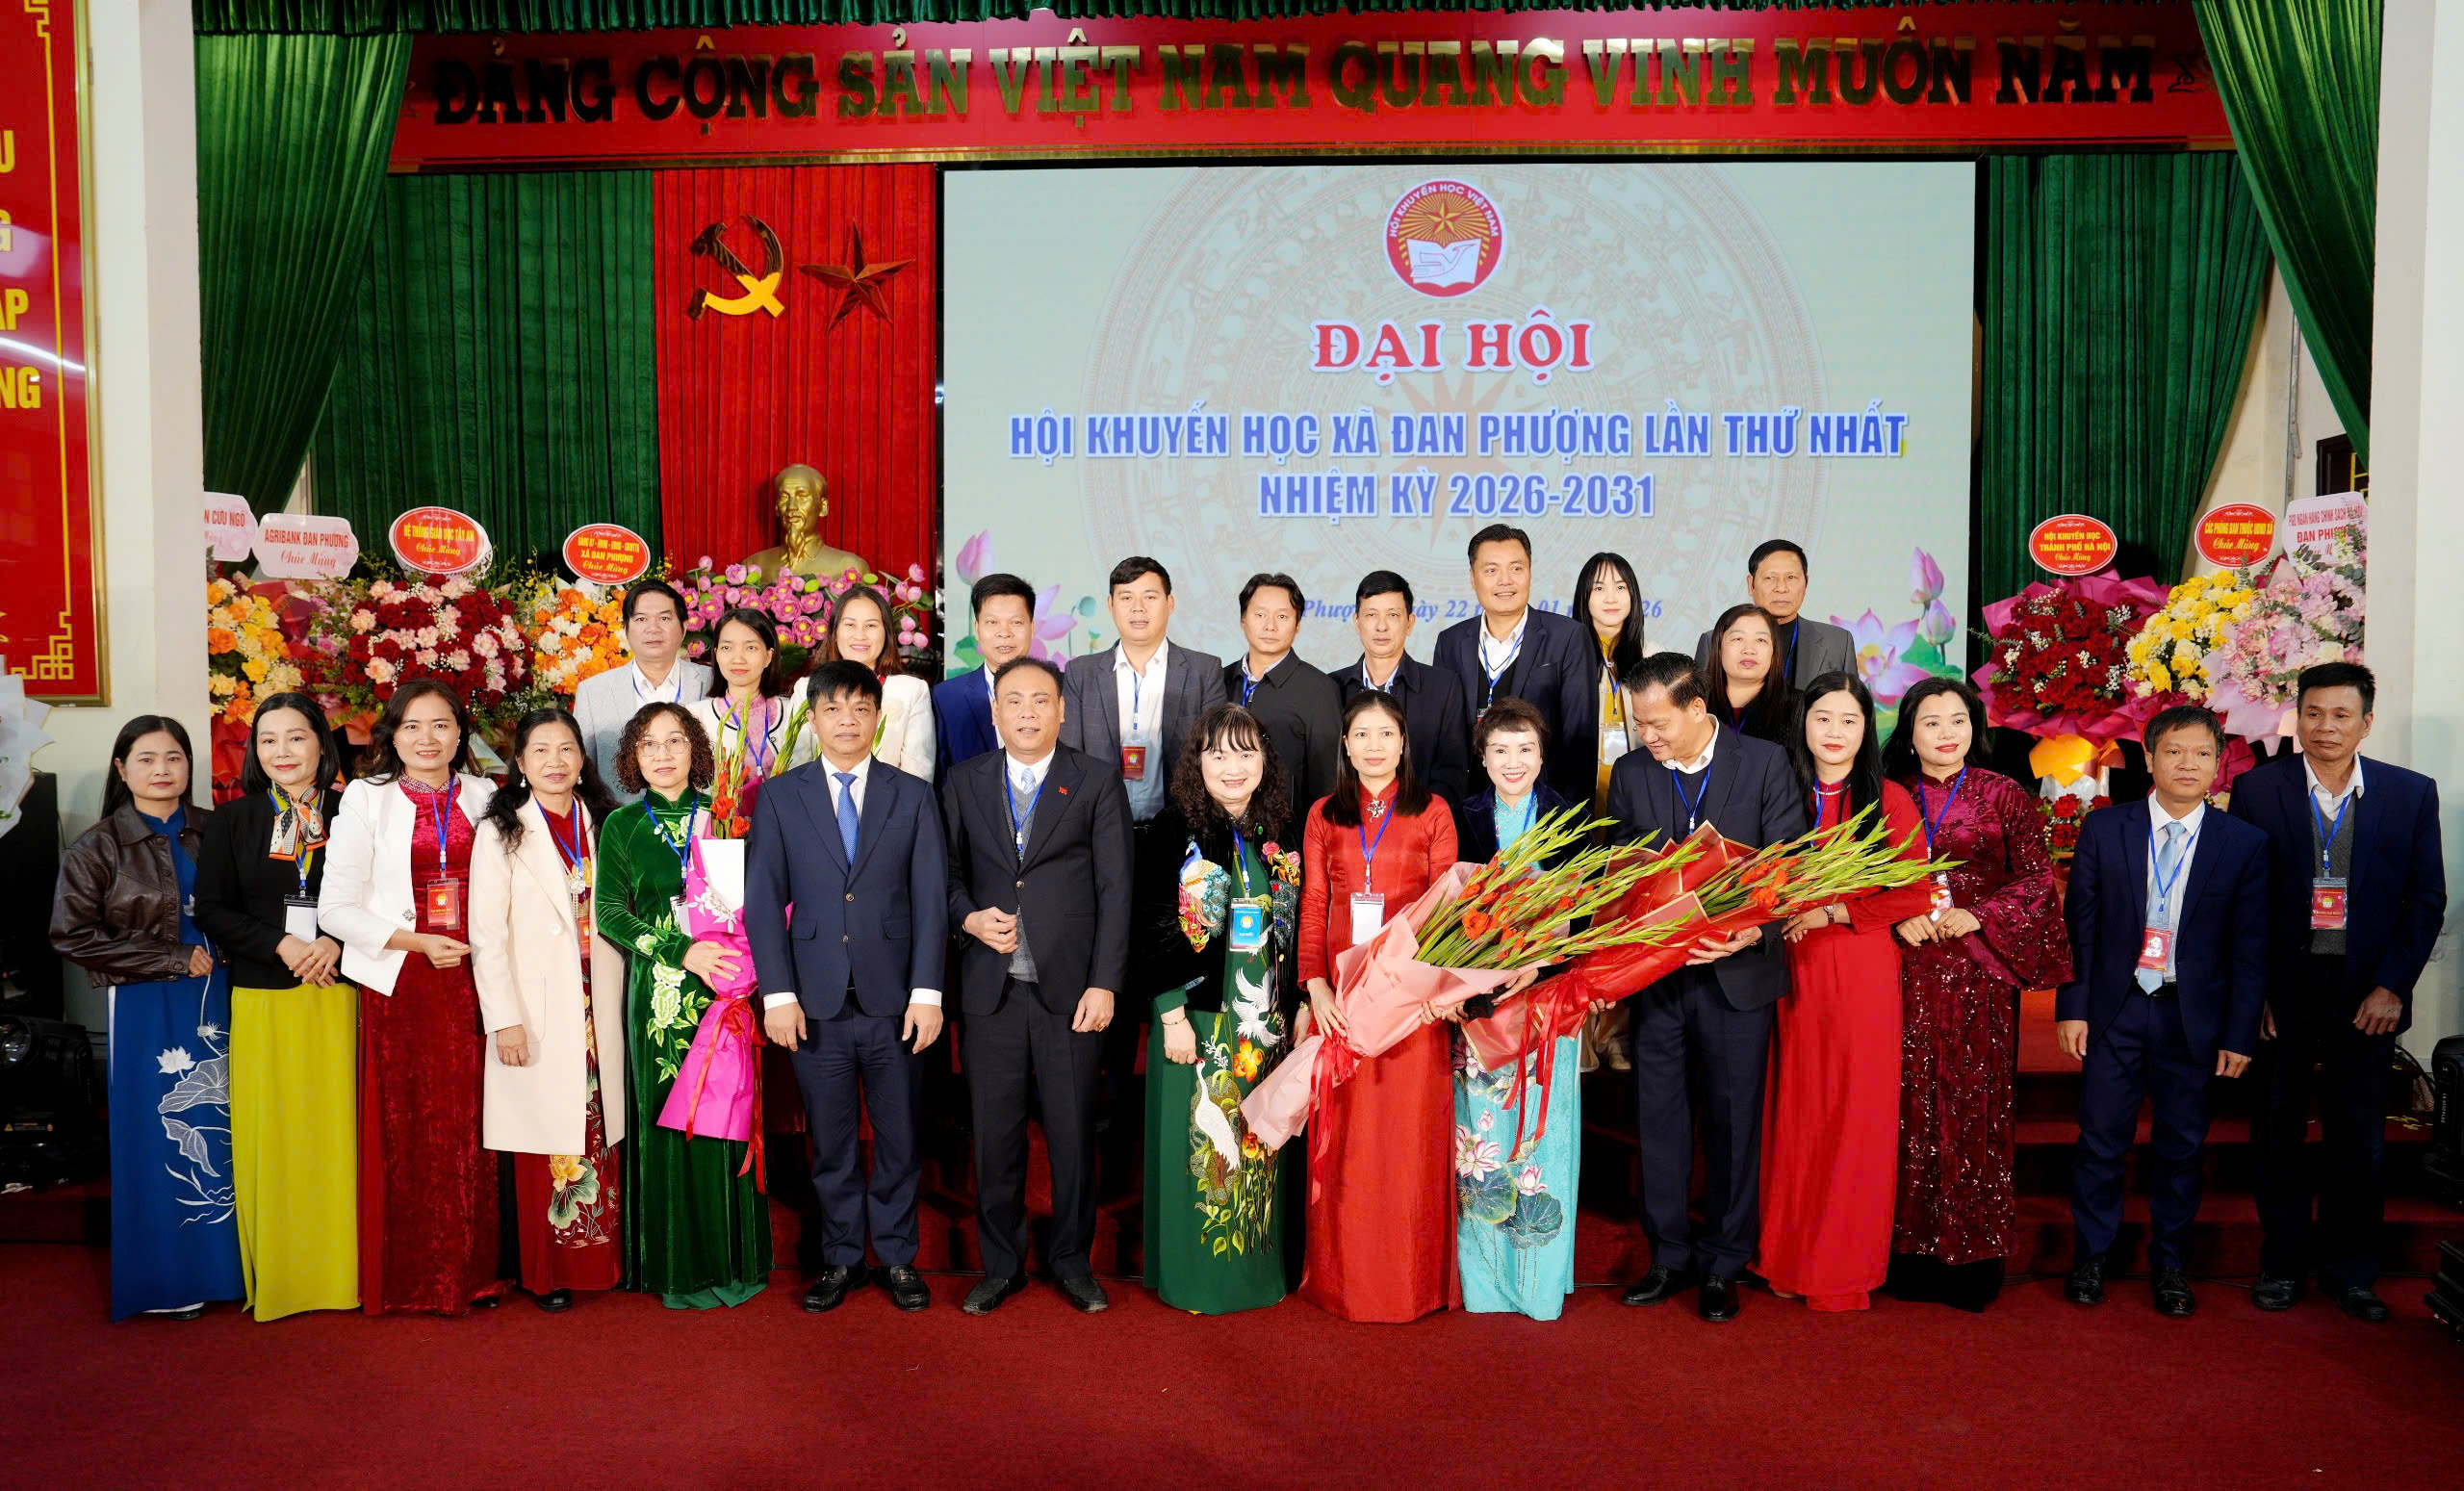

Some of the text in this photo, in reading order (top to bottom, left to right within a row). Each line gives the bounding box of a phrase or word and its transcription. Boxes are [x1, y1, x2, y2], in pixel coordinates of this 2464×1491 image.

[431, 15, 2157, 136] ĐẢNG CỘNG SẢN VIỆT NAM QUANG VINH MUÔN NĂM
[1389, 183, 1500, 238] HỘI KHUYẾN HỌC VIỆT NAM
[1312, 307, 1593, 383] ĐẠI HỘI
[1010, 398, 1908, 464] HỘI KHUYẾN HỌC XÃ ĐAN PHƯỢNG LẦN THỨ NHẤT
[1259, 466, 1655, 525] NHIỆM KỲ 2026-2031
[265, 528, 349, 549] AGRIBANK ĐAN PHƯỢNG
[2043, 529, 2100, 541] HỘI KHUYẾN HỌC
[2213, 537, 2261, 553] Chúc Mừng
[2297, 530, 2315, 543] ĐAN
[416, 542, 437, 553] Chúc
[2040, 541, 2111, 553] THÀNH PHỐ HÀ NỘI
[280, 549, 337, 568] Chúc Mừng
[1302, 600, 1355, 622] Phượ
[1444, 600, 1469, 618] 22
[1537, 600, 1559, 617] 01
